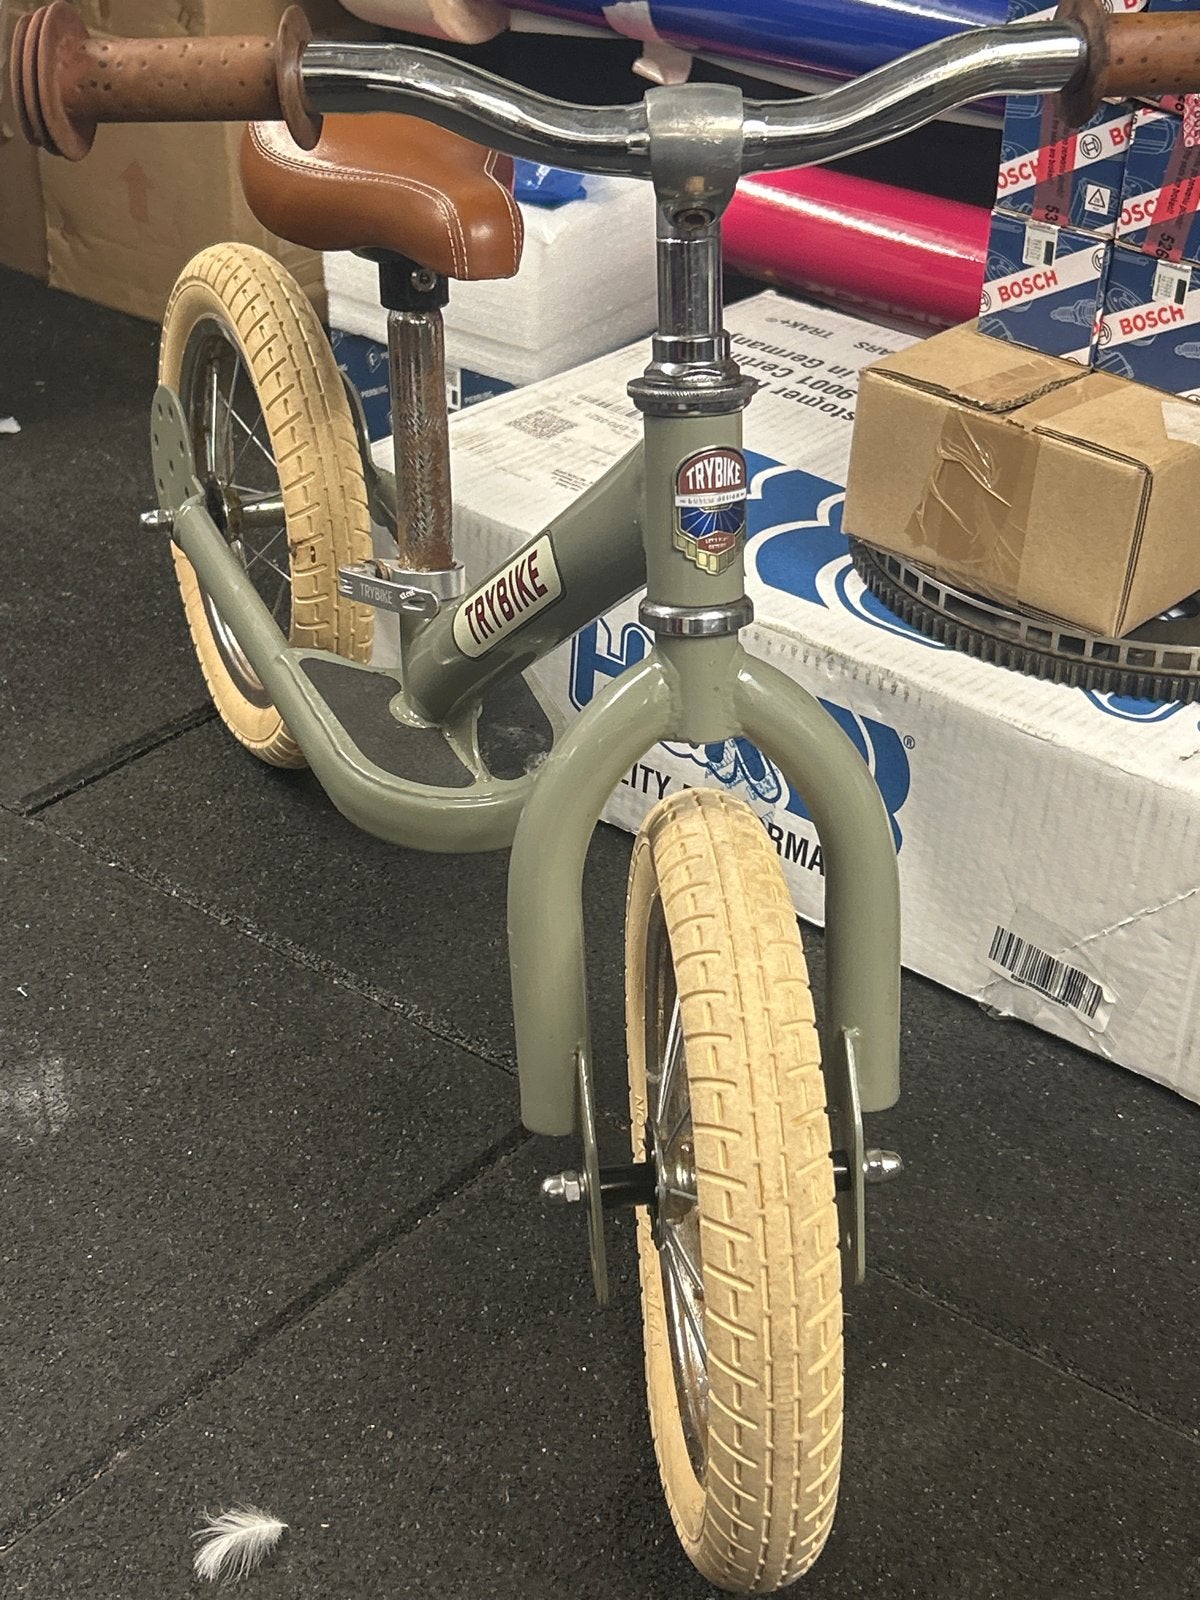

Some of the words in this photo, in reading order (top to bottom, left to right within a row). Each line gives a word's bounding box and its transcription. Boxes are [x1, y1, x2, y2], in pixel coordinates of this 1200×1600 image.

[1155, 232, 1175, 258] 526
[997, 270, 1058, 303] BOSCH
[1119, 305, 1185, 336] BOSCH
[827, 365, 854, 379] in
[770, 387, 855, 421] stomer
[686, 457, 741, 490] TRYBIKE
[360, 583, 393, 605] TRYBIKE
[465, 549, 548, 645] TRYBIKE
